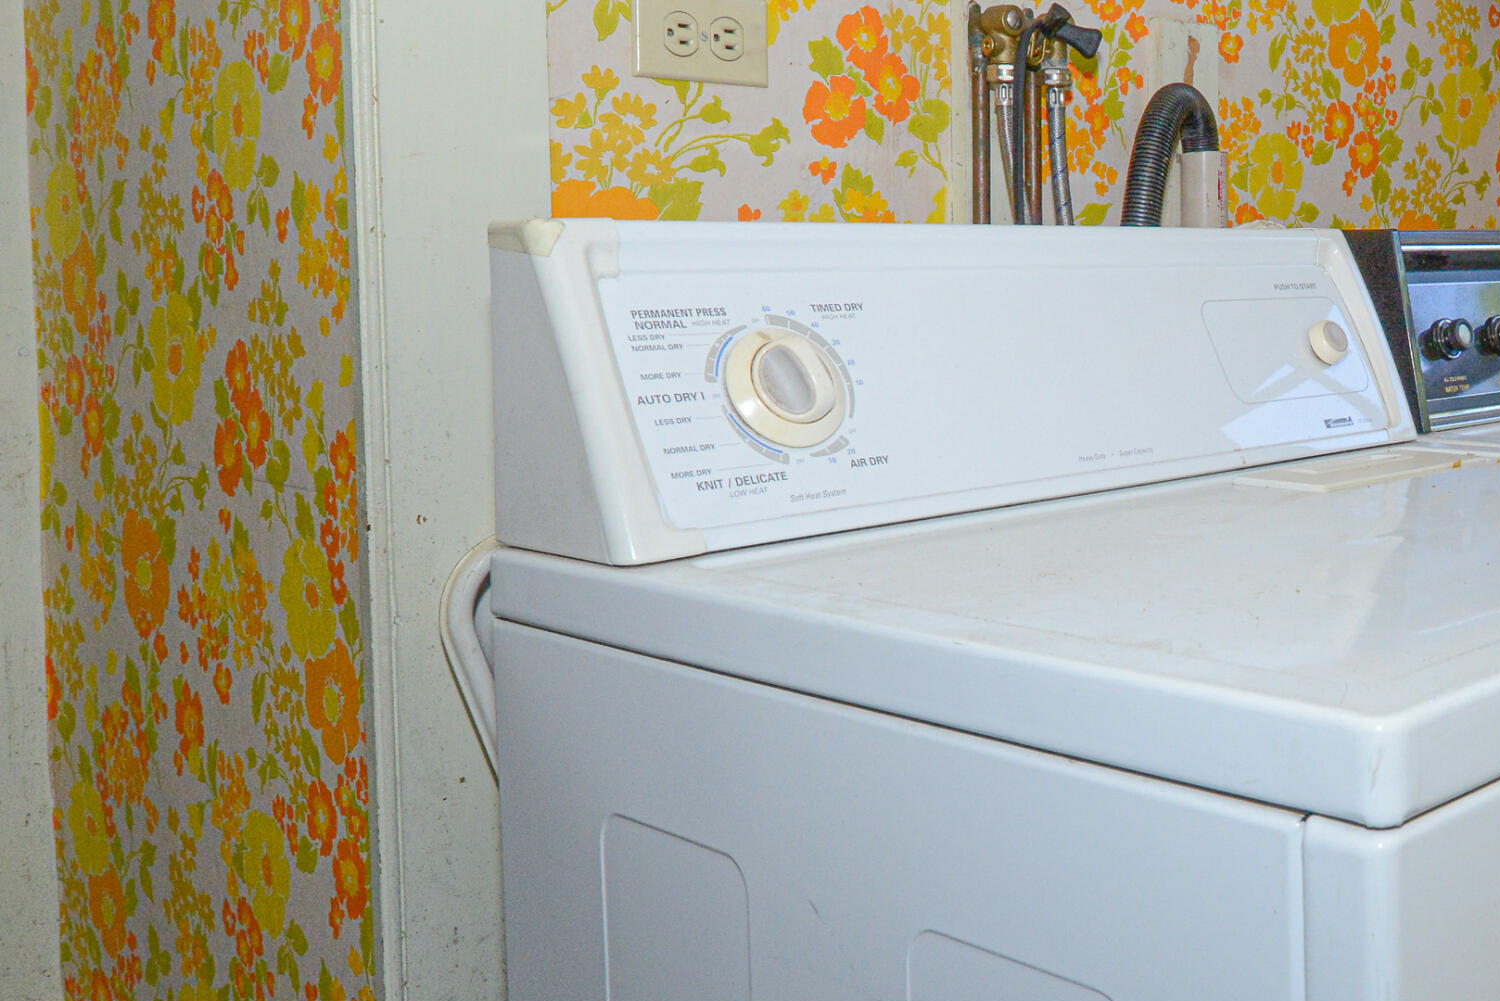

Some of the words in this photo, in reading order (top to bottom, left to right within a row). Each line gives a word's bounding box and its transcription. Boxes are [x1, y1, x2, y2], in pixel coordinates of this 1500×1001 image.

[630, 308, 693, 319] PERMANENT
[695, 307, 728, 318] PRESS
[810, 303, 842, 313] TIMED
[844, 302, 864, 312] DRY
[634, 320, 688, 331] NORMAL
[628, 334, 649, 342] LESS
[649, 333, 665, 341] DRY
[631, 344, 667, 352] NORMAL
[667, 343, 683, 351] DRY
[640, 372, 665, 380] MORE
[665, 371, 681, 379] DRY
[637, 394, 672, 406] AUTO
[674, 391, 697, 403] DRY
[654, 418, 675, 427] LESS
[676, 416, 693, 425] DRY
[663, 445, 699, 455] NORMAL
[699, 443, 716, 452] DRY
[850, 457, 868, 469] AIR
[869, 455, 889, 467] DRY
[671, 470, 695, 480] MORE
[696, 468, 712, 477] DRY
[696, 479, 724, 492] KNIT
[734, 471, 788, 487] DELICATE
[729, 488, 747, 499] LOW
[749, 486, 769, 495] HEAT
